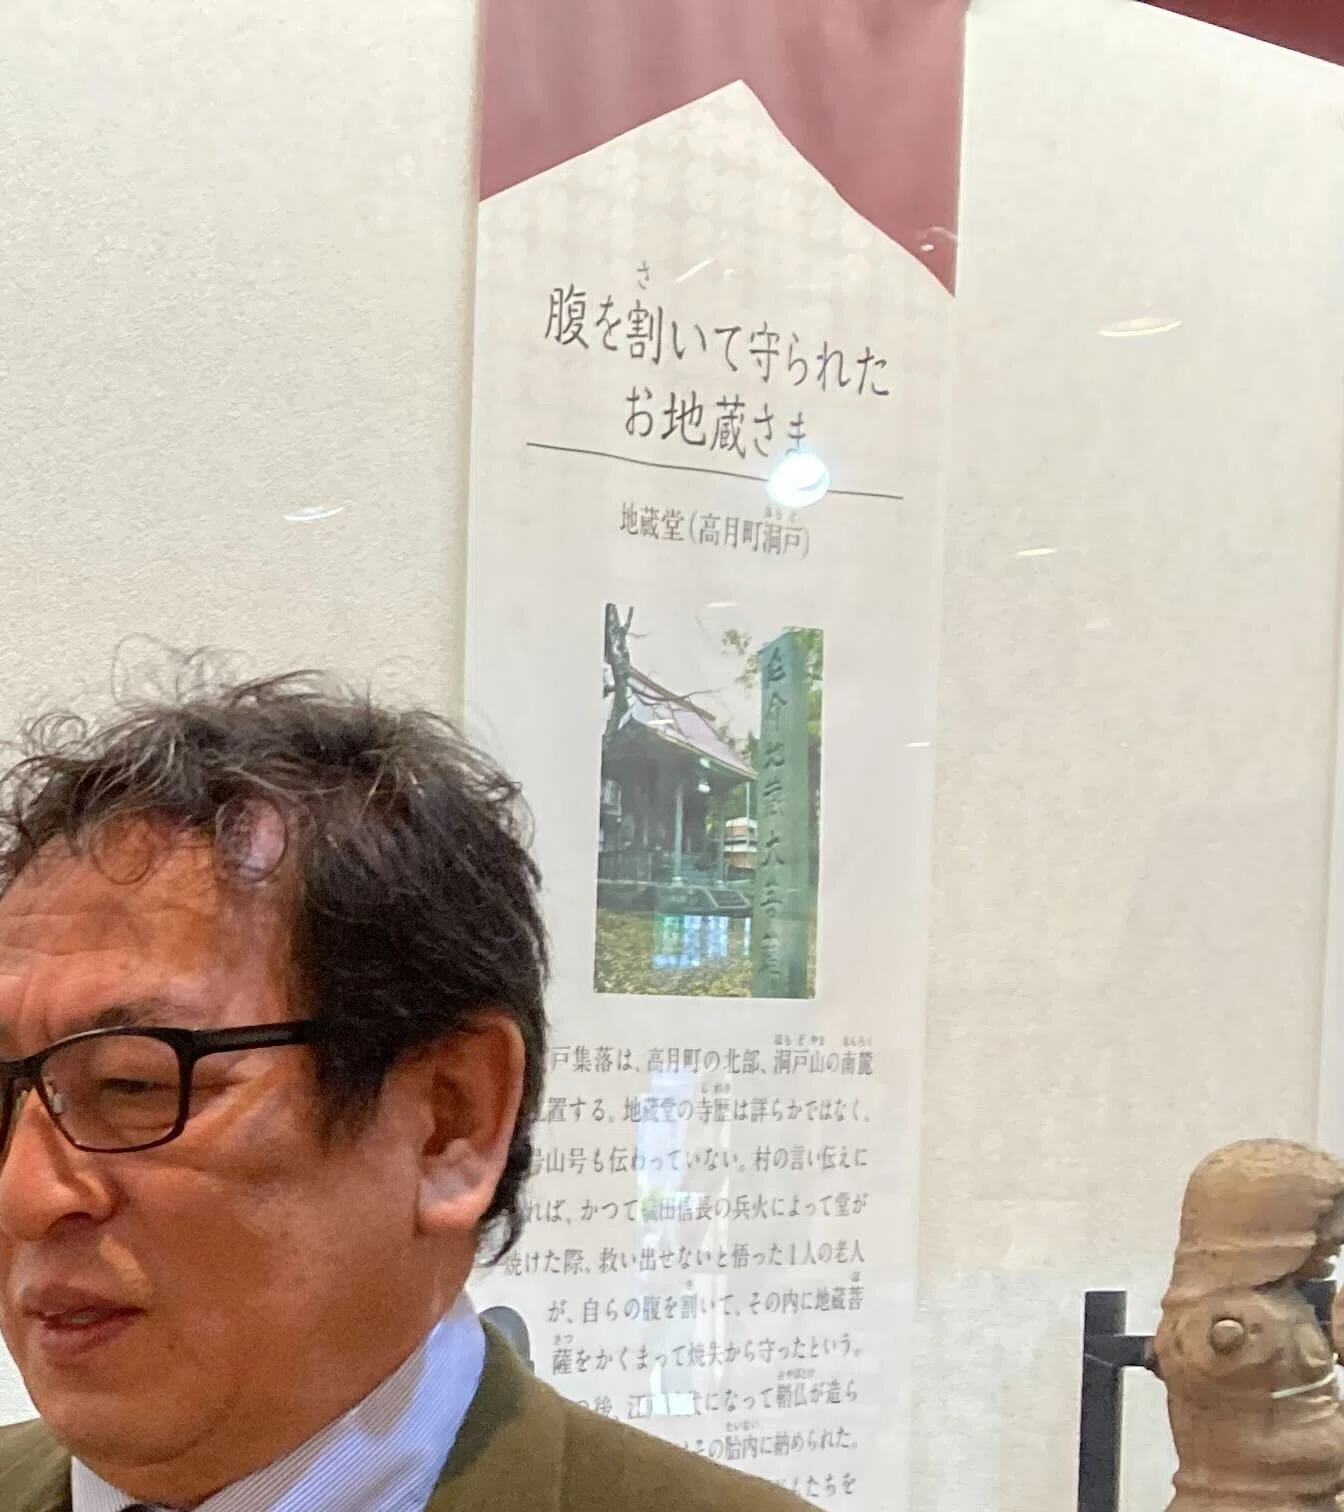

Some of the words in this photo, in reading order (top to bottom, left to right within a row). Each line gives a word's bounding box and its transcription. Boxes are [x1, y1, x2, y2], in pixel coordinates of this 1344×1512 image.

[544, 283, 889, 396] 腹を割いて守られた
